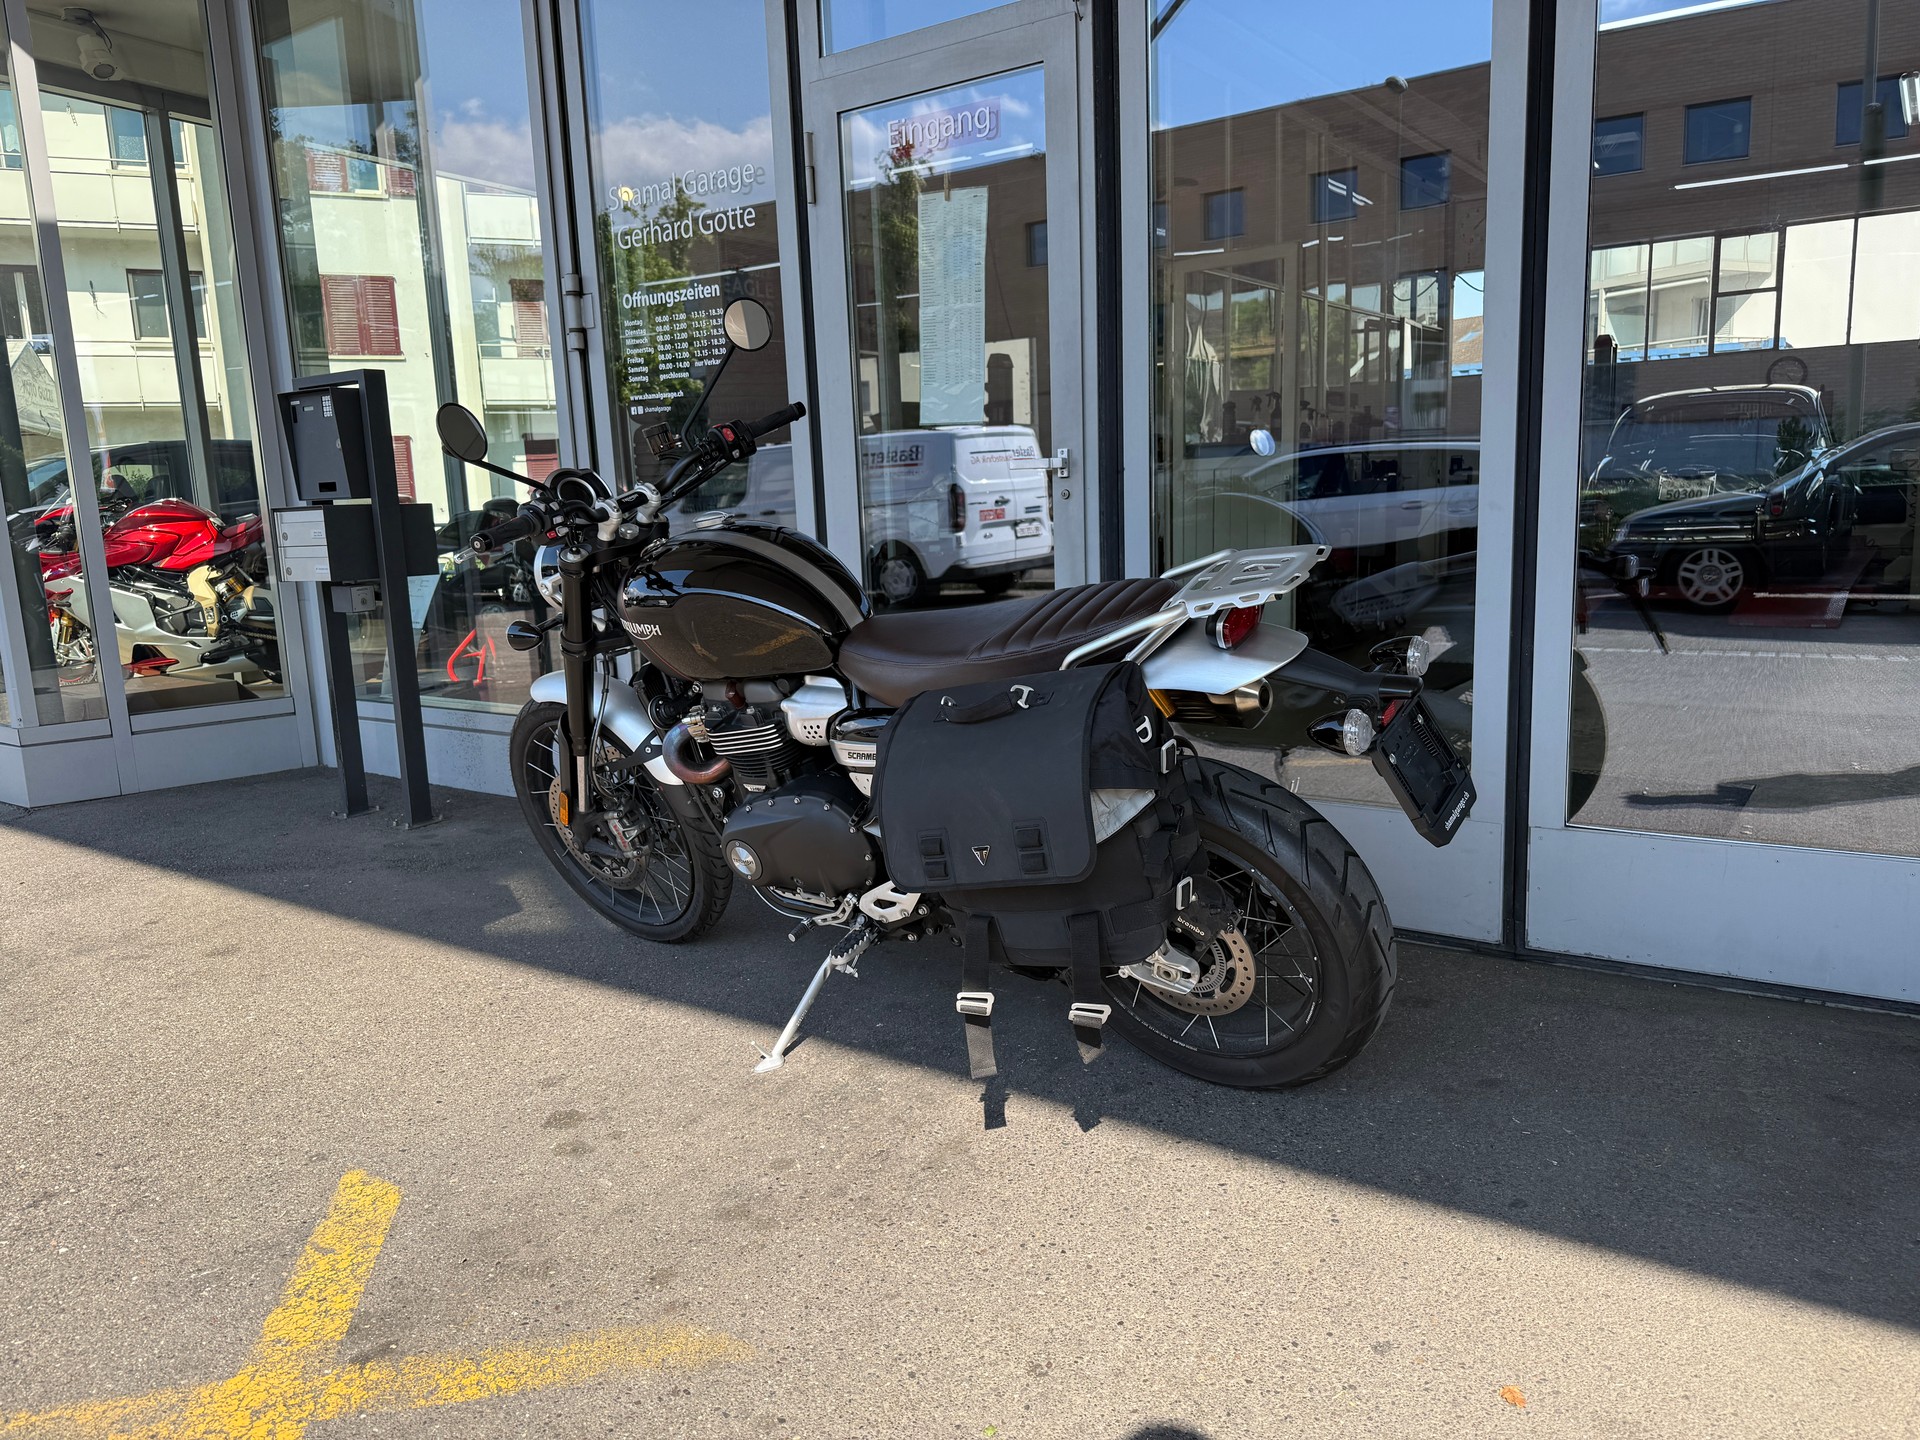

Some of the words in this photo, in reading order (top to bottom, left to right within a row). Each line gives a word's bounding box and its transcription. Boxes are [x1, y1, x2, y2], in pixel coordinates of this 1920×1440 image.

[888, 106, 990, 149] Eingang
[608, 172, 677, 211] Shamal
[682, 163, 755, 195] Garage
[617, 211, 693, 250] Gerhard
[692, 310, 706, 318] 13.15
[710, 308, 724, 316] 18.30
[626, 337, 648, 346] Mittwoch
[692, 330, 707, 338] 13.15
[694, 340, 708, 348] 13.15
[711, 338, 726, 346] 18.30
[694, 349, 708, 357] 13.15
[712, 348, 726, 356] 18.30
[660, 372, 690, 382] geschlossen
[630, 390, 684, 400] www.shamalgarage.ch
[644, 406, 672, 414] shamalgarage
[848, 752, 876, 760] SCRAMB
[1444, 790, 1470, 831] shamalgarage.ch
[1177, 916, 1205, 936] brembo
